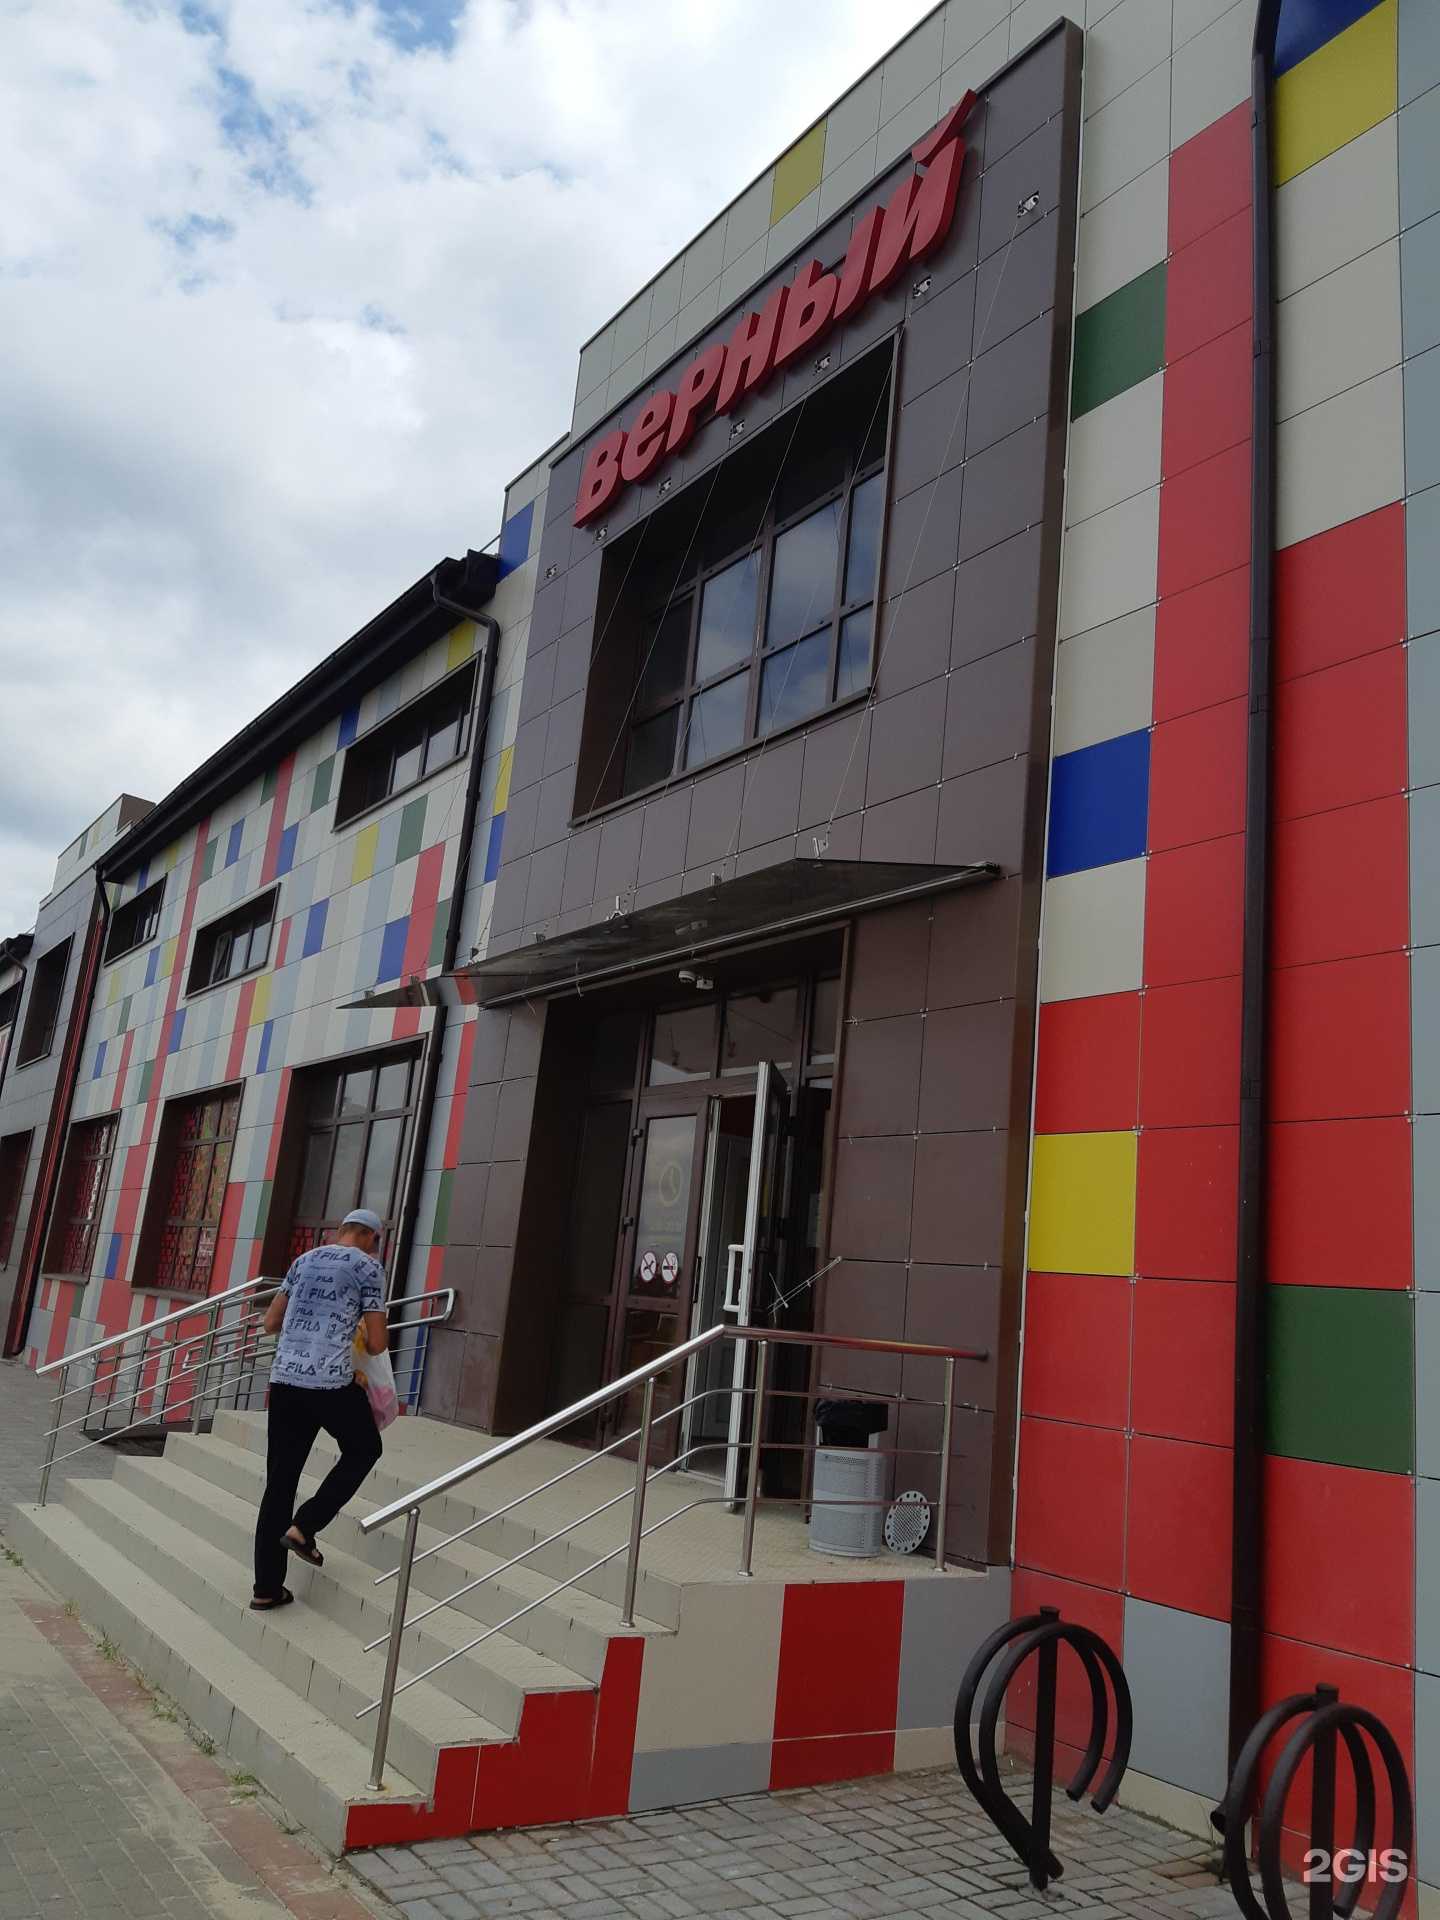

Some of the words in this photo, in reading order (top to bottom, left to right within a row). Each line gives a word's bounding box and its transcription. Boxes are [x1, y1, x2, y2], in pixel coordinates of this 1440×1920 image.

[320, 1252, 351, 1262] FILA
[315, 1275, 334, 1283] FILA
[309, 1288, 337, 1301] FILA
[296, 1307, 313, 1317] FILA
[295, 1319, 321, 1332] FILA
[285, 1362, 317, 1377] FILA
